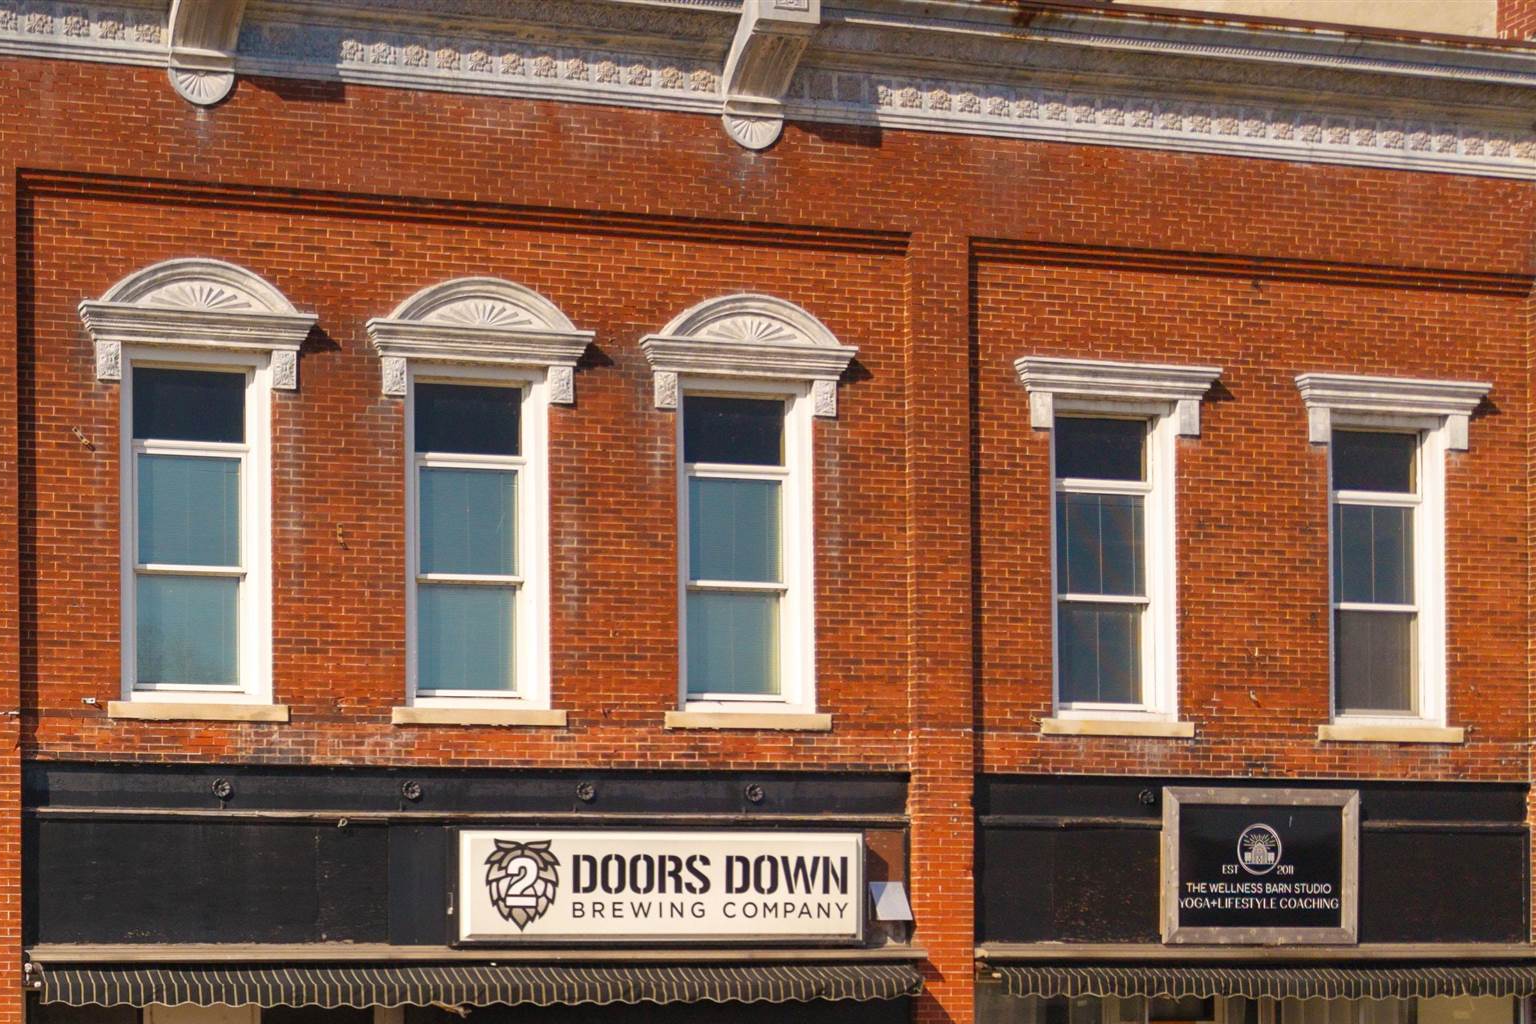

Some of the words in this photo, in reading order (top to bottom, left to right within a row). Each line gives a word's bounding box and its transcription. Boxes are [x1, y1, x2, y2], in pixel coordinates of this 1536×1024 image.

[1222, 864, 1239, 874] EST
[1276, 864, 1294, 875] 2011
[505, 857, 539, 907] 2
[572, 853, 711, 895] DOORS
[725, 854, 848, 895] DOWN
[1186, 882, 1207, 893] THE
[1209, 882, 1263, 894] WELLNESS
[1265, 882, 1292, 894] BARN
[1294, 883, 1332, 894] STUDIO
[572, 901, 706, 919] BREWING
[722, 901, 849, 919] COMPANY
[1279, 897, 1339, 910] COACHING
